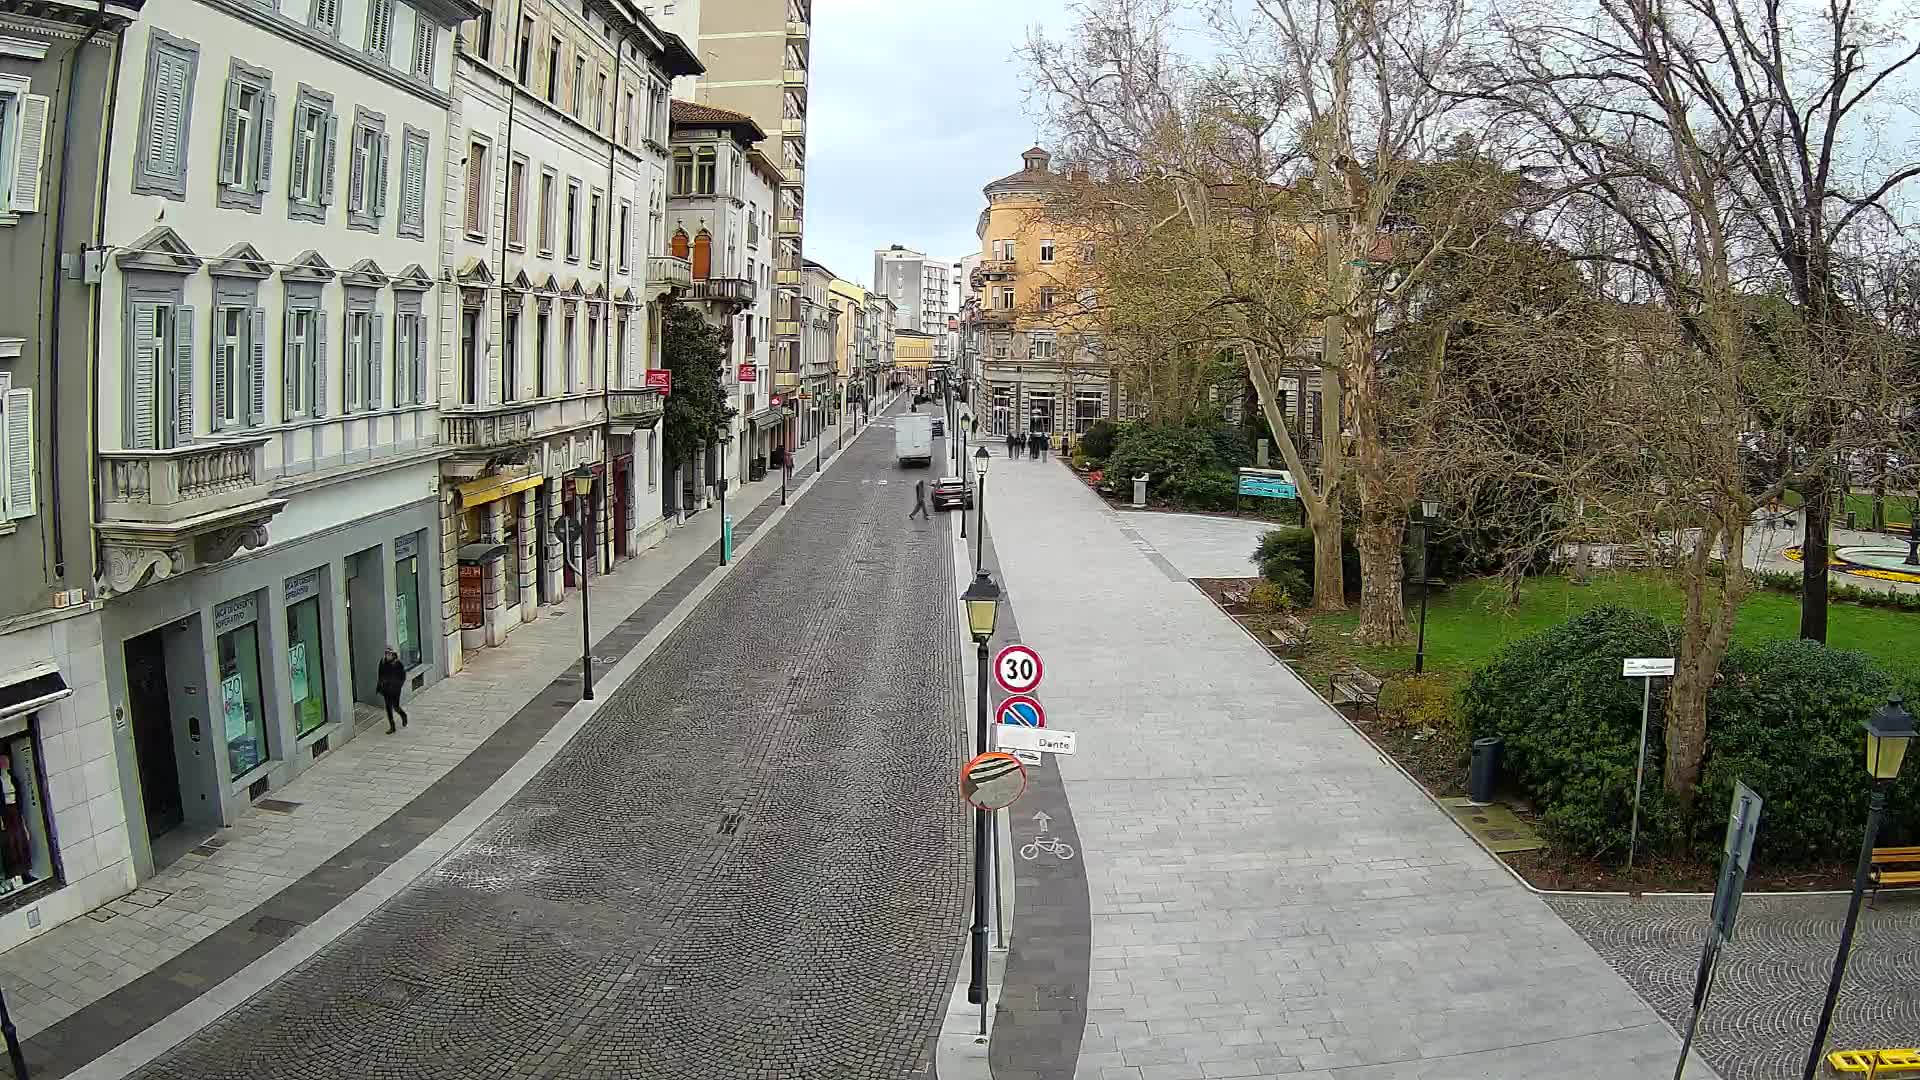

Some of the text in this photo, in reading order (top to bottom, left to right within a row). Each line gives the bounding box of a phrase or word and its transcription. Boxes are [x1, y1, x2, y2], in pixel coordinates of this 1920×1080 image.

[1006, 658, 1033, 680] 30
[222, 677, 241, 701] 130
[1039, 738, 1070, 750] Dante
